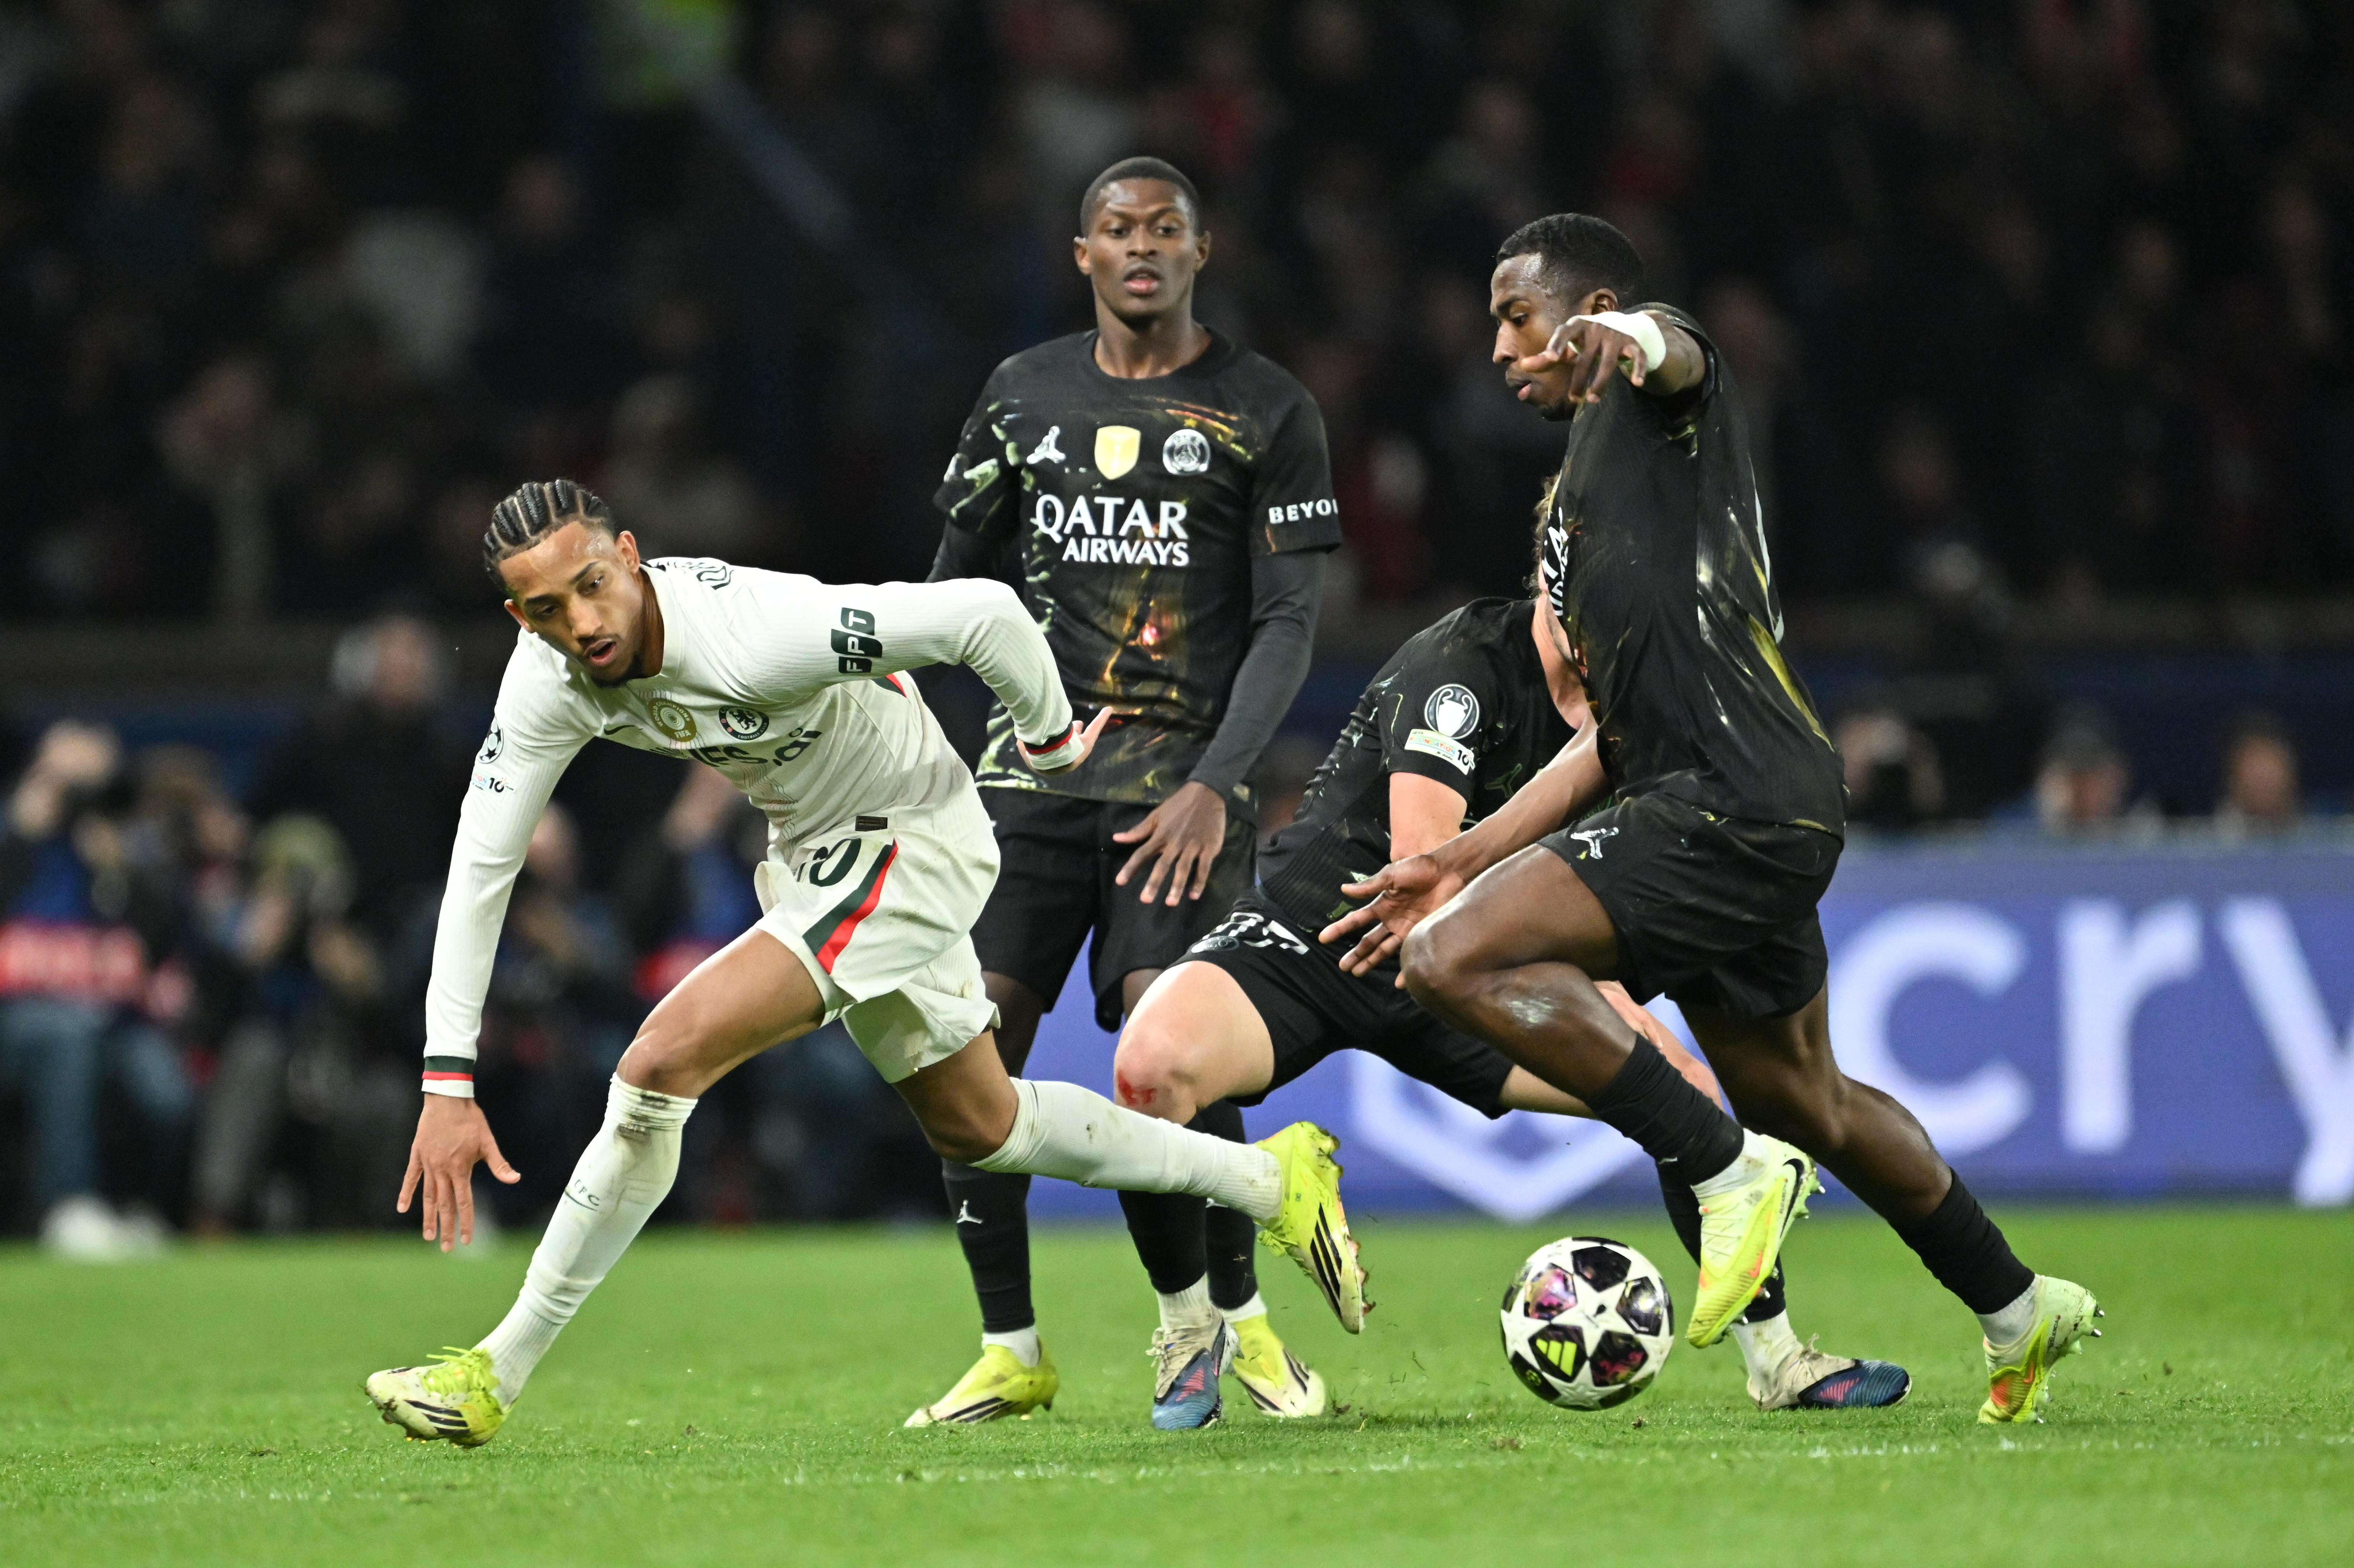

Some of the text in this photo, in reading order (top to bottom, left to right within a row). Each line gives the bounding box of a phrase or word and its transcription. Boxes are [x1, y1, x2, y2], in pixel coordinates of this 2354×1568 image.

[1035, 494, 1189, 544] QATAR
[1062, 537, 1190, 567] AIRWAYS
[846, 610, 867, 672] FPT
[674, 730, 691, 739] FIFA
[1457, 749, 1469, 766] 10
[489, 777, 505, 793] 10
